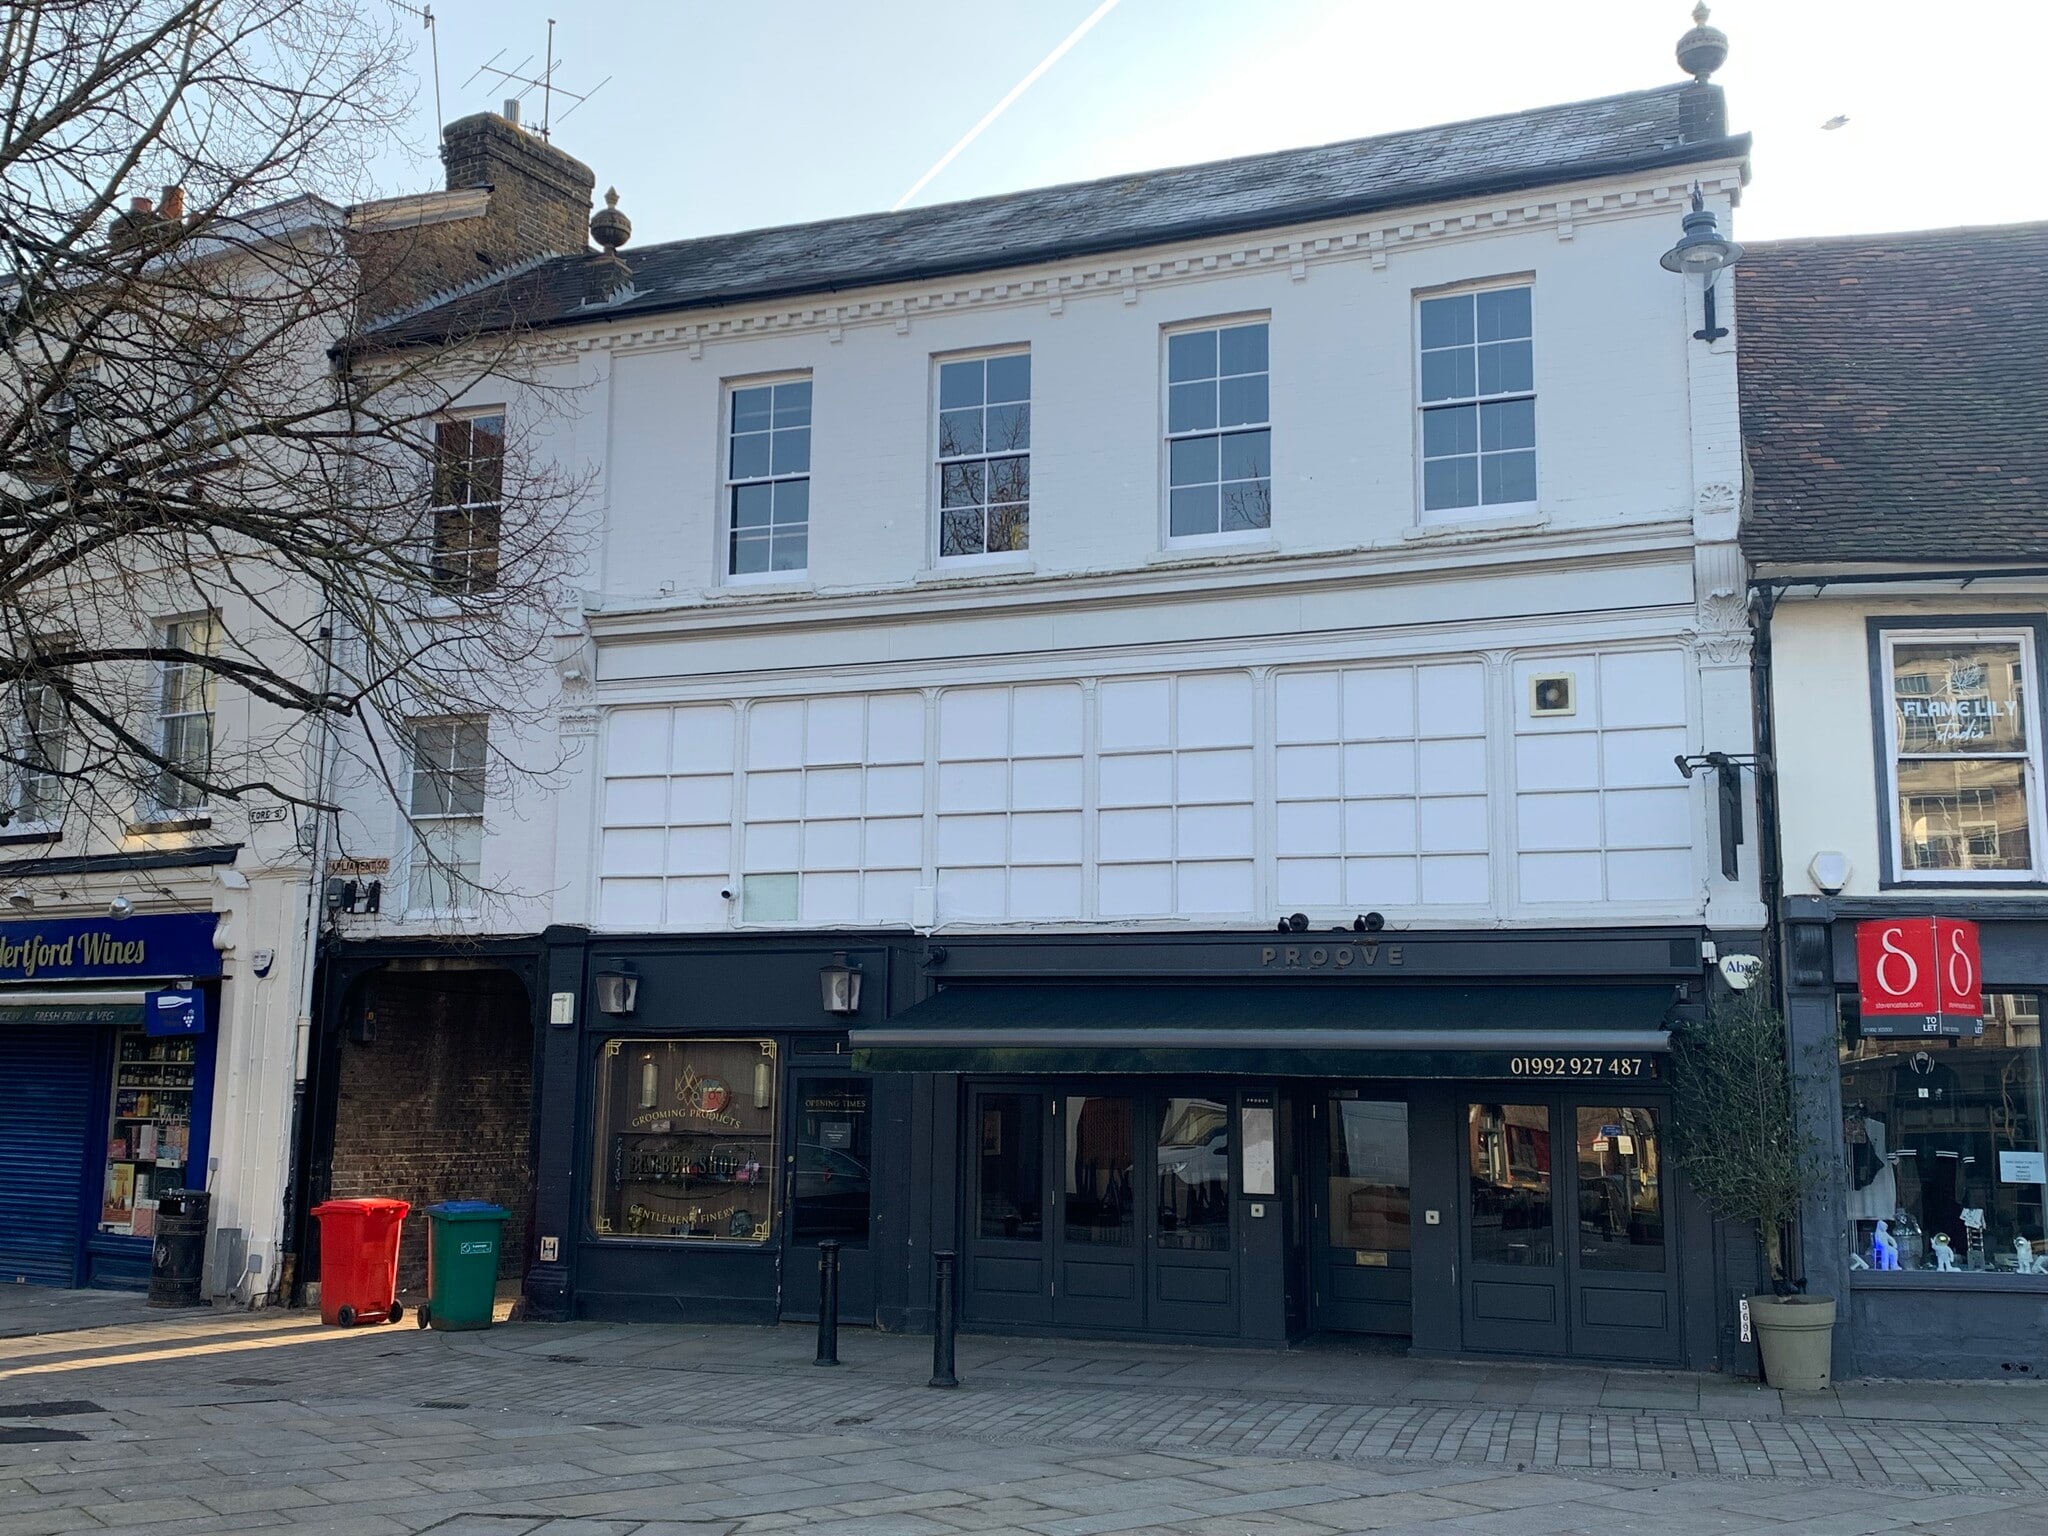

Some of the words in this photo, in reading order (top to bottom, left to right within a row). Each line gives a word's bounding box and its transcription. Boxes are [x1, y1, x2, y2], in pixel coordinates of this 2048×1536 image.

[1904, 701, 1970, 716] FLAME
[1975, 701, 2017, 716] LILY
[1936, 719, 1985, 745] studio
[251, 810, 271, 819] FORE
[78, 932, 145, 965] Wines
[1262, 946, 1404, 966] PROOVE
[34, 1011, 60, 1020] FRESH
[96, 1010, 114, 1020] VEG
[1926, 1016, 1937, 1024] TO
[1923, 1024, 1937, 1032] LET
[1511, 1057, 1565, 1075] 01992
[1570, 1058, 1603, 1075] 927
[1608, 1058, 1642, 1076] 487
[805, 1099, 840, 1107] OPENING
[843, 1100, 866, 1108] TIMES
[631, 1108, 686, 1127] GROOMING
[690, 1109, 742, 1129] PRODUCTS
[630, 1155, 690, 1174] BARBER
[699, 1156, 739, 1174] SHOP
[700, 1206, 735, 1222] FINERY
